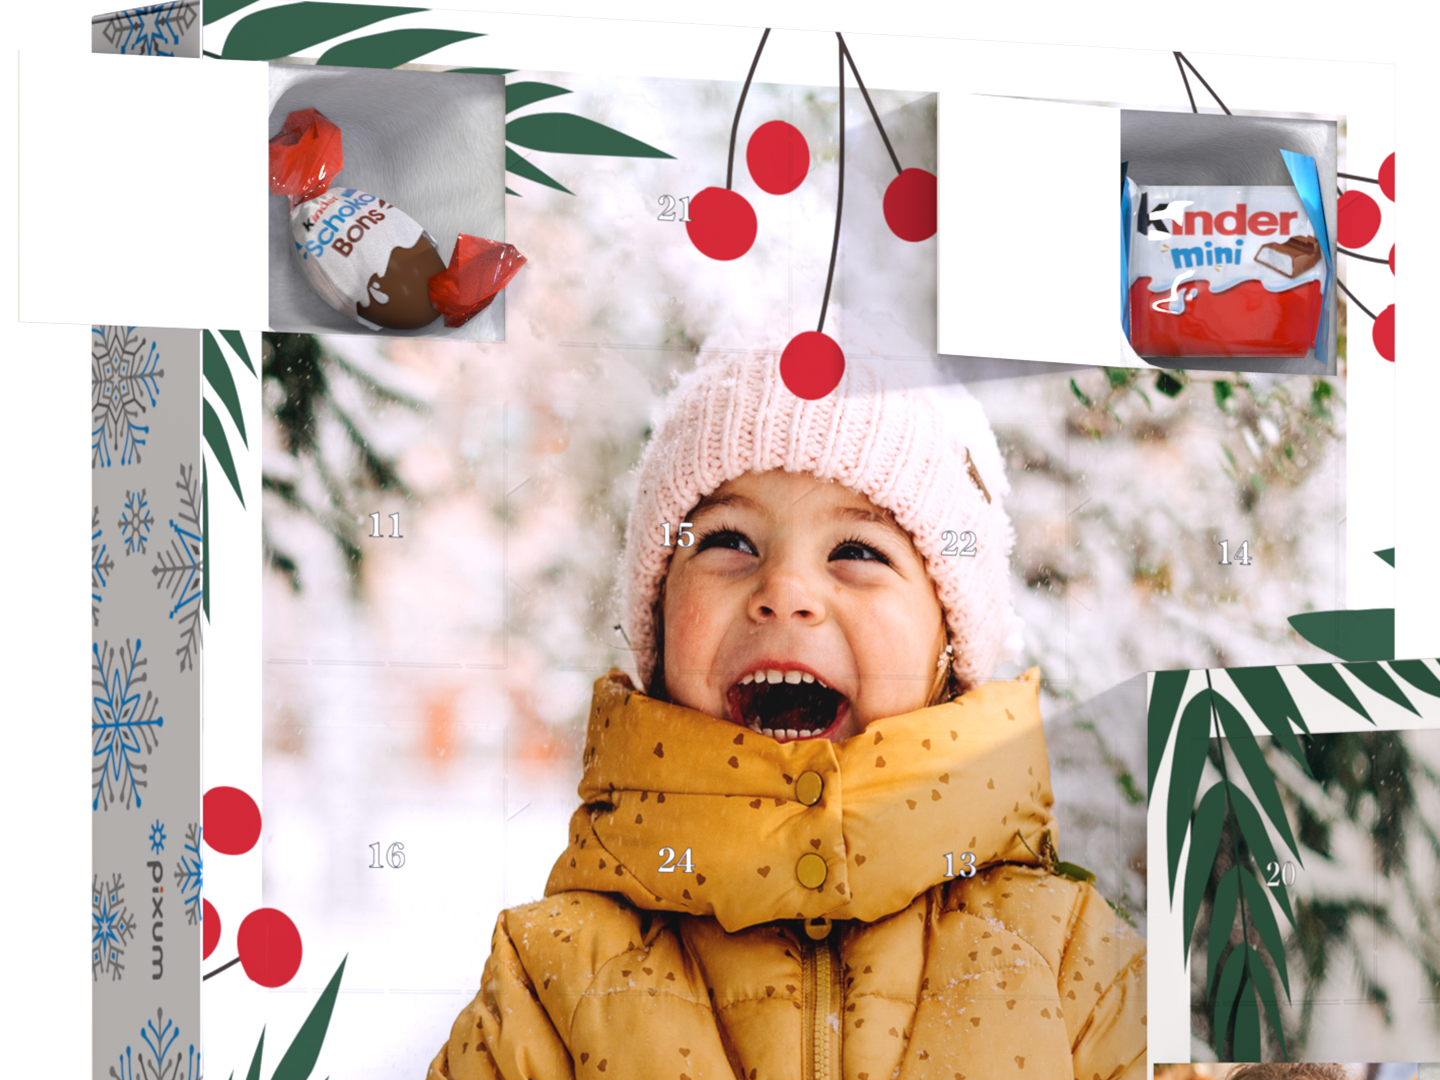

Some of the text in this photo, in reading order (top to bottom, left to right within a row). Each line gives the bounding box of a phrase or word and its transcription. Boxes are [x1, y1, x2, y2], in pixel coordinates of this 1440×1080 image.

[657, 194, 693, 222] 21
[331, 209, 386, 258] Bons
[1170, 238, 1244, 270] mini
[368, 511, 404, 538] 11
[659, 521, 695, 548] 15
[940, 529, 977, 557] 22
[1217, 539, 1253, 566] 14
[368, 841, 406, 869] 16
[657, 846, 696, 873] 24
[942, 851, 977, 879] 13
[1266, 861, 1296, 887] 20
[146, 861, 164, 980] pixum
